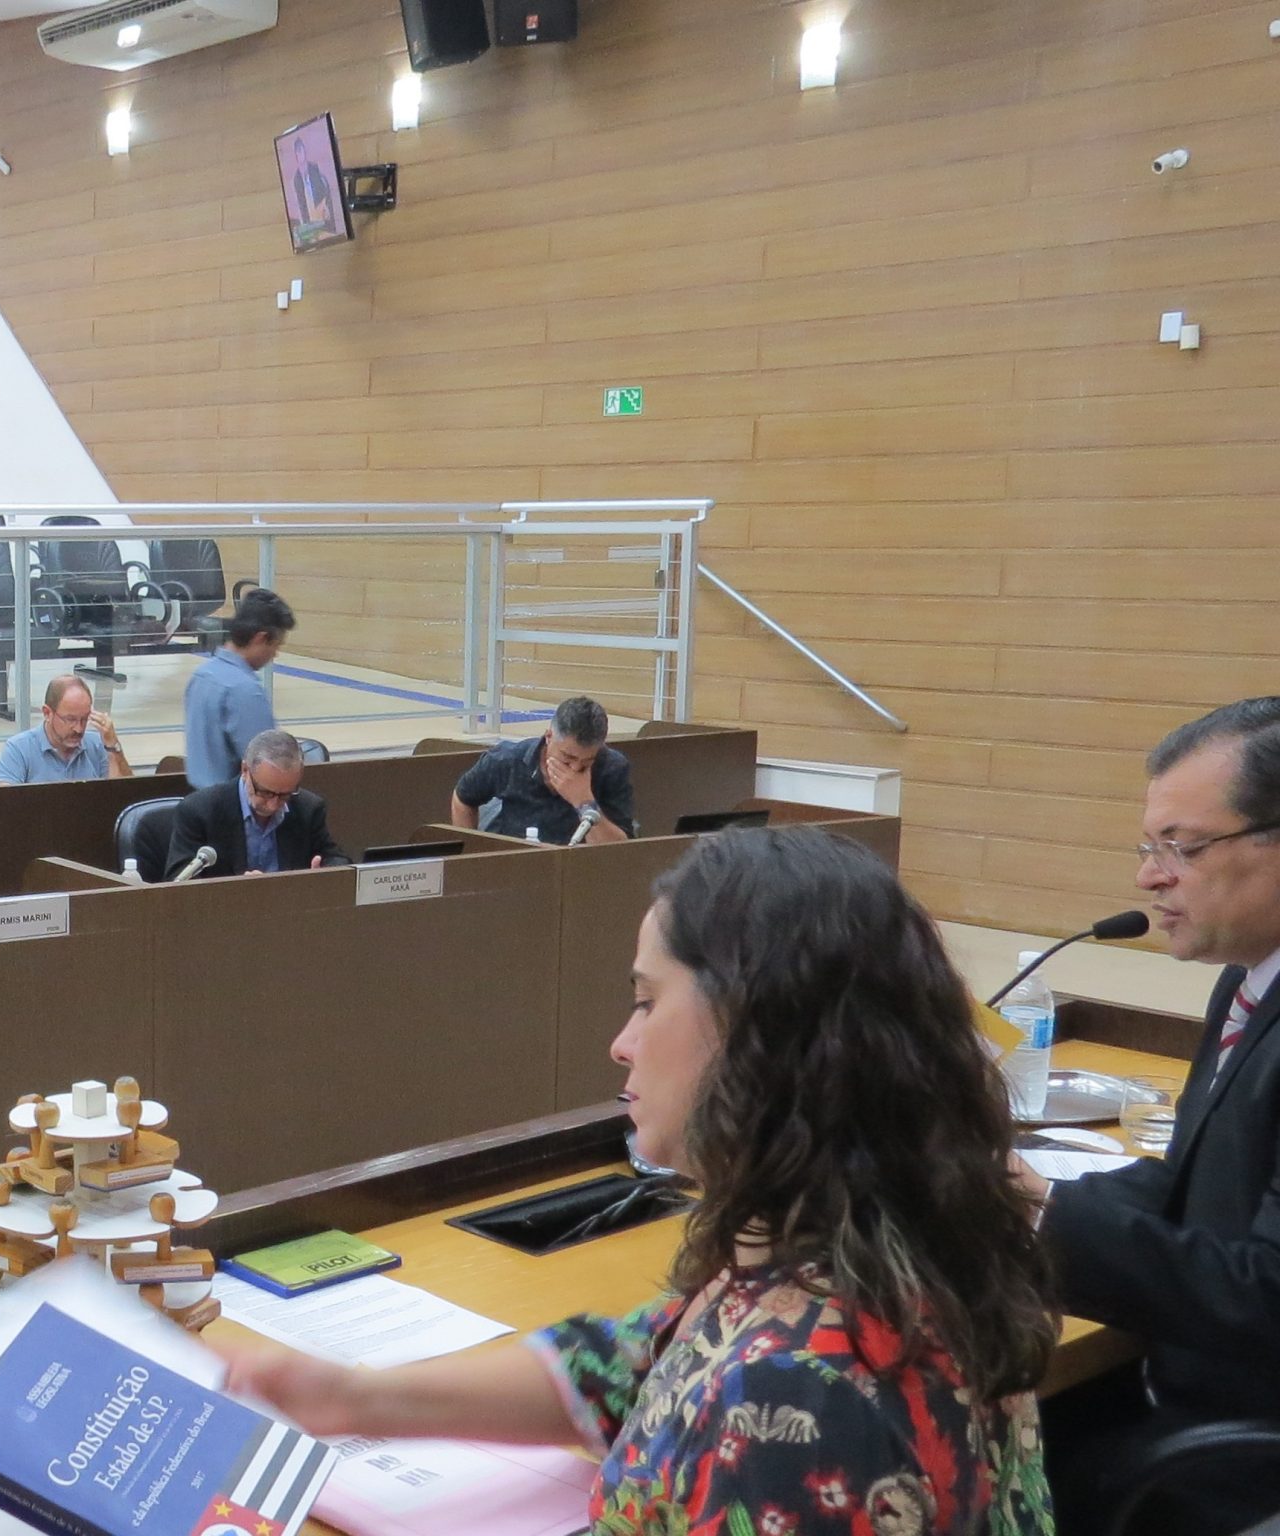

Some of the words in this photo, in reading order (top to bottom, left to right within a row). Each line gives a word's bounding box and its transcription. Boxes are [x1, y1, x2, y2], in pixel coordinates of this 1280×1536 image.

[373, 875, 402, 885] CARLOS
[22, 913, 52, 923] MARINI
[307, 1255, 354, 1274] PILOT
[35, 1367, 72, 1409] LEGISLATIVA
[194, 1402, 215, 1426] Brasil
[47, 1366, 150, 1486] Constituição
[187, 1424, 201, 1438] do
[93, 1442, 141, 1491] Estado
[128, 1422, 154, 1443] de
[162, 1436, 195, 1477] Federativa
[365, 1454, 402, 1471] DO
[395, 1468, 441, 1486] DIA
[139, 1474, 170, 1511] República
[132, 1518, 141, 1527] e
[133, 1507, 147, 1521] da
